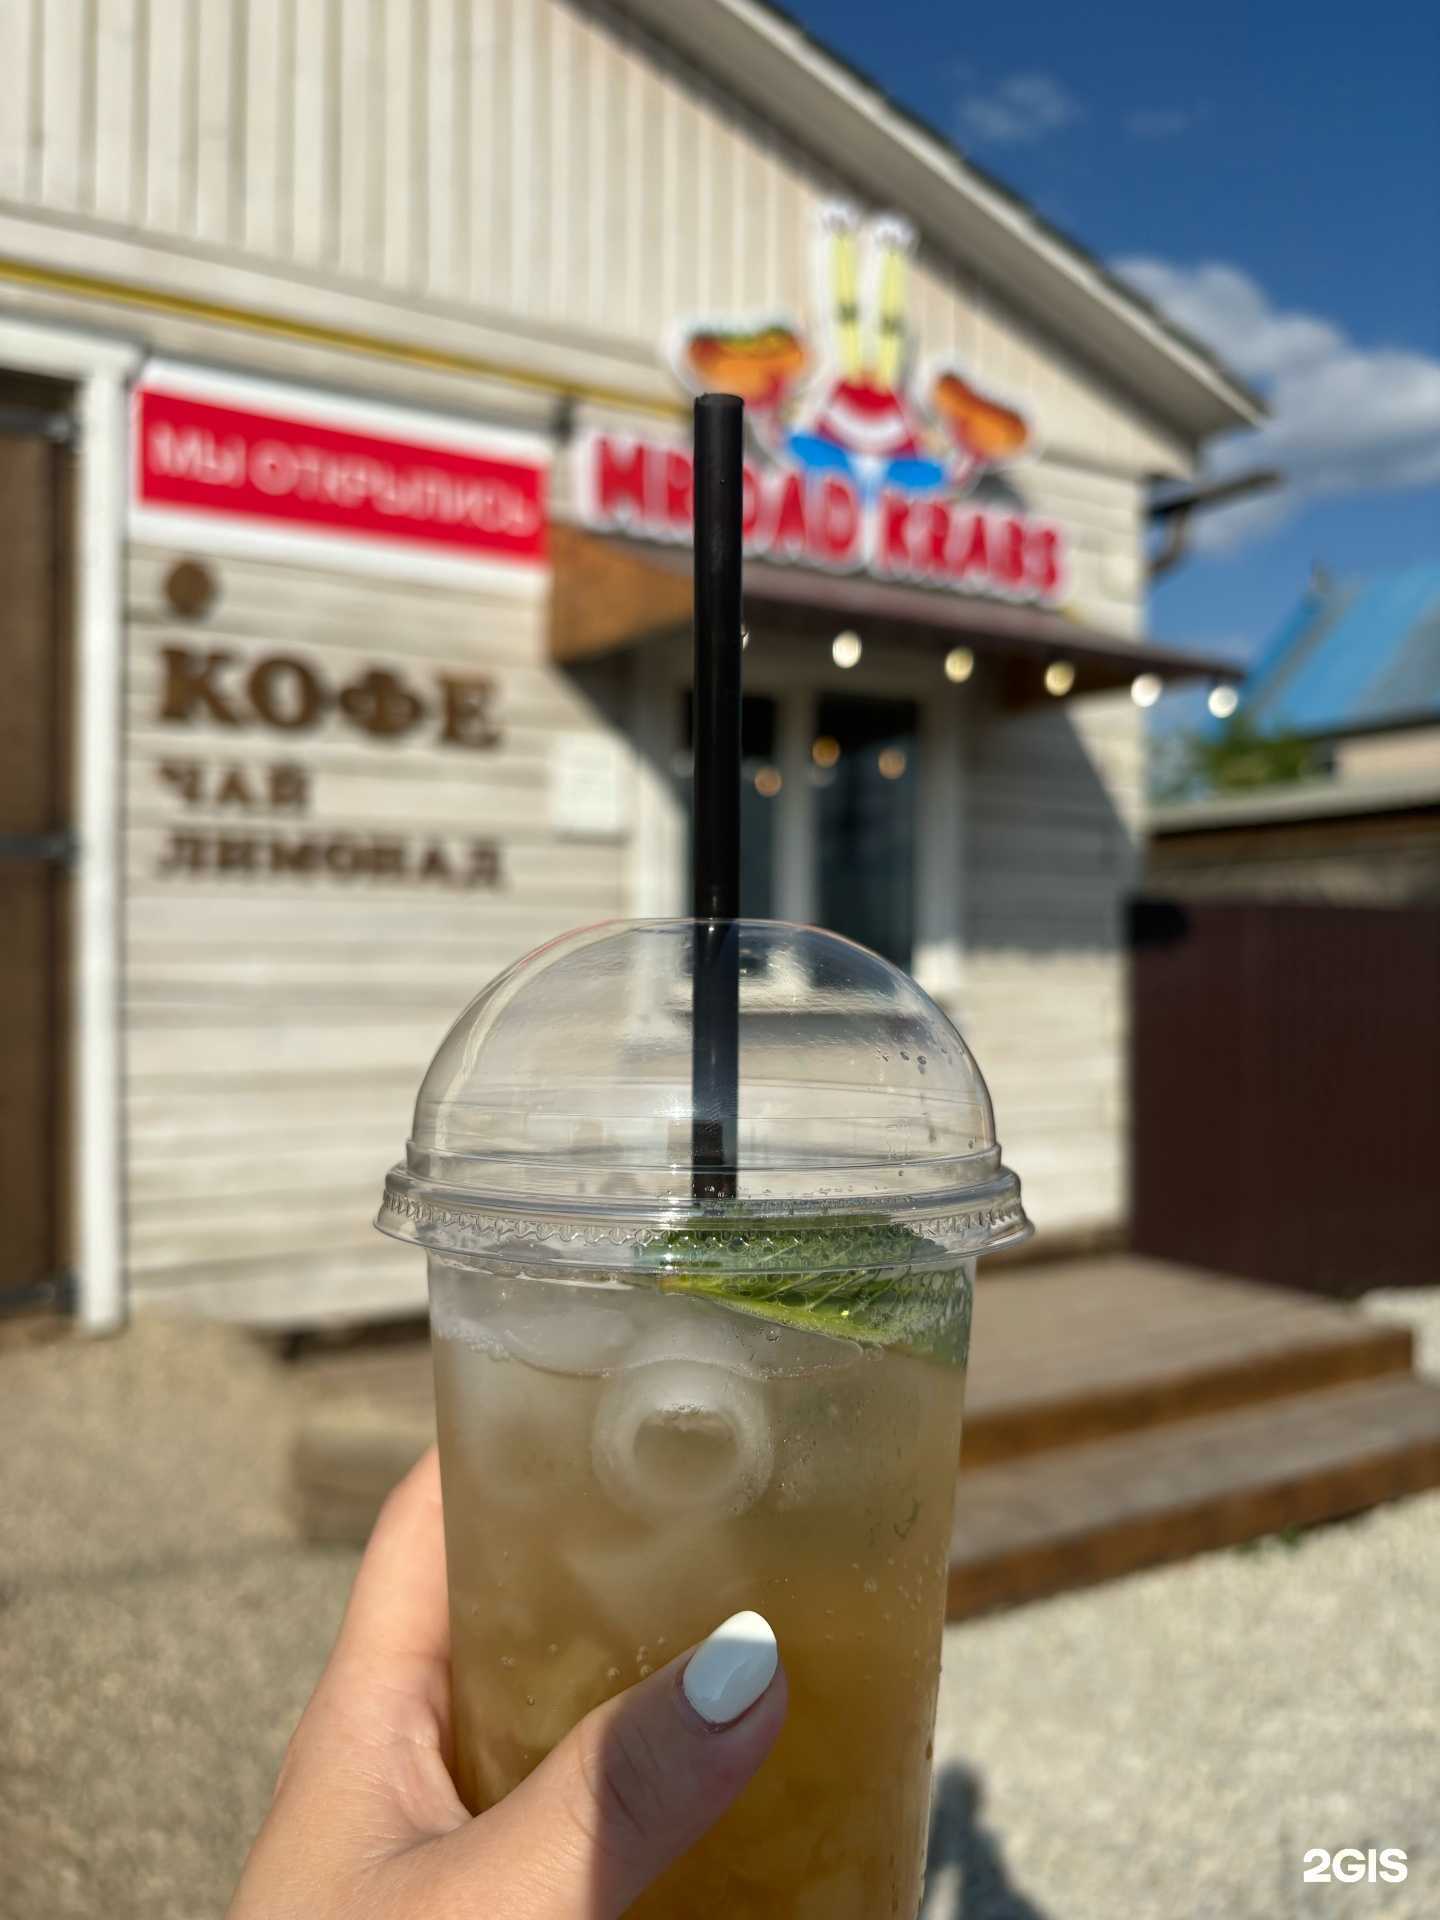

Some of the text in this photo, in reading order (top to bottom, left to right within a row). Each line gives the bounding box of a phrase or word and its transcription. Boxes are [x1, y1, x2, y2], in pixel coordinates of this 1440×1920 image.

[149, 421, 540, 538] МЫ ОТКРЫЛИСЬ
[879, 490, 1064, 592] KRABS
[158, 647, 502, 749] КОФЕ
[155, 828, 506, 890] ЛИМОНАД
